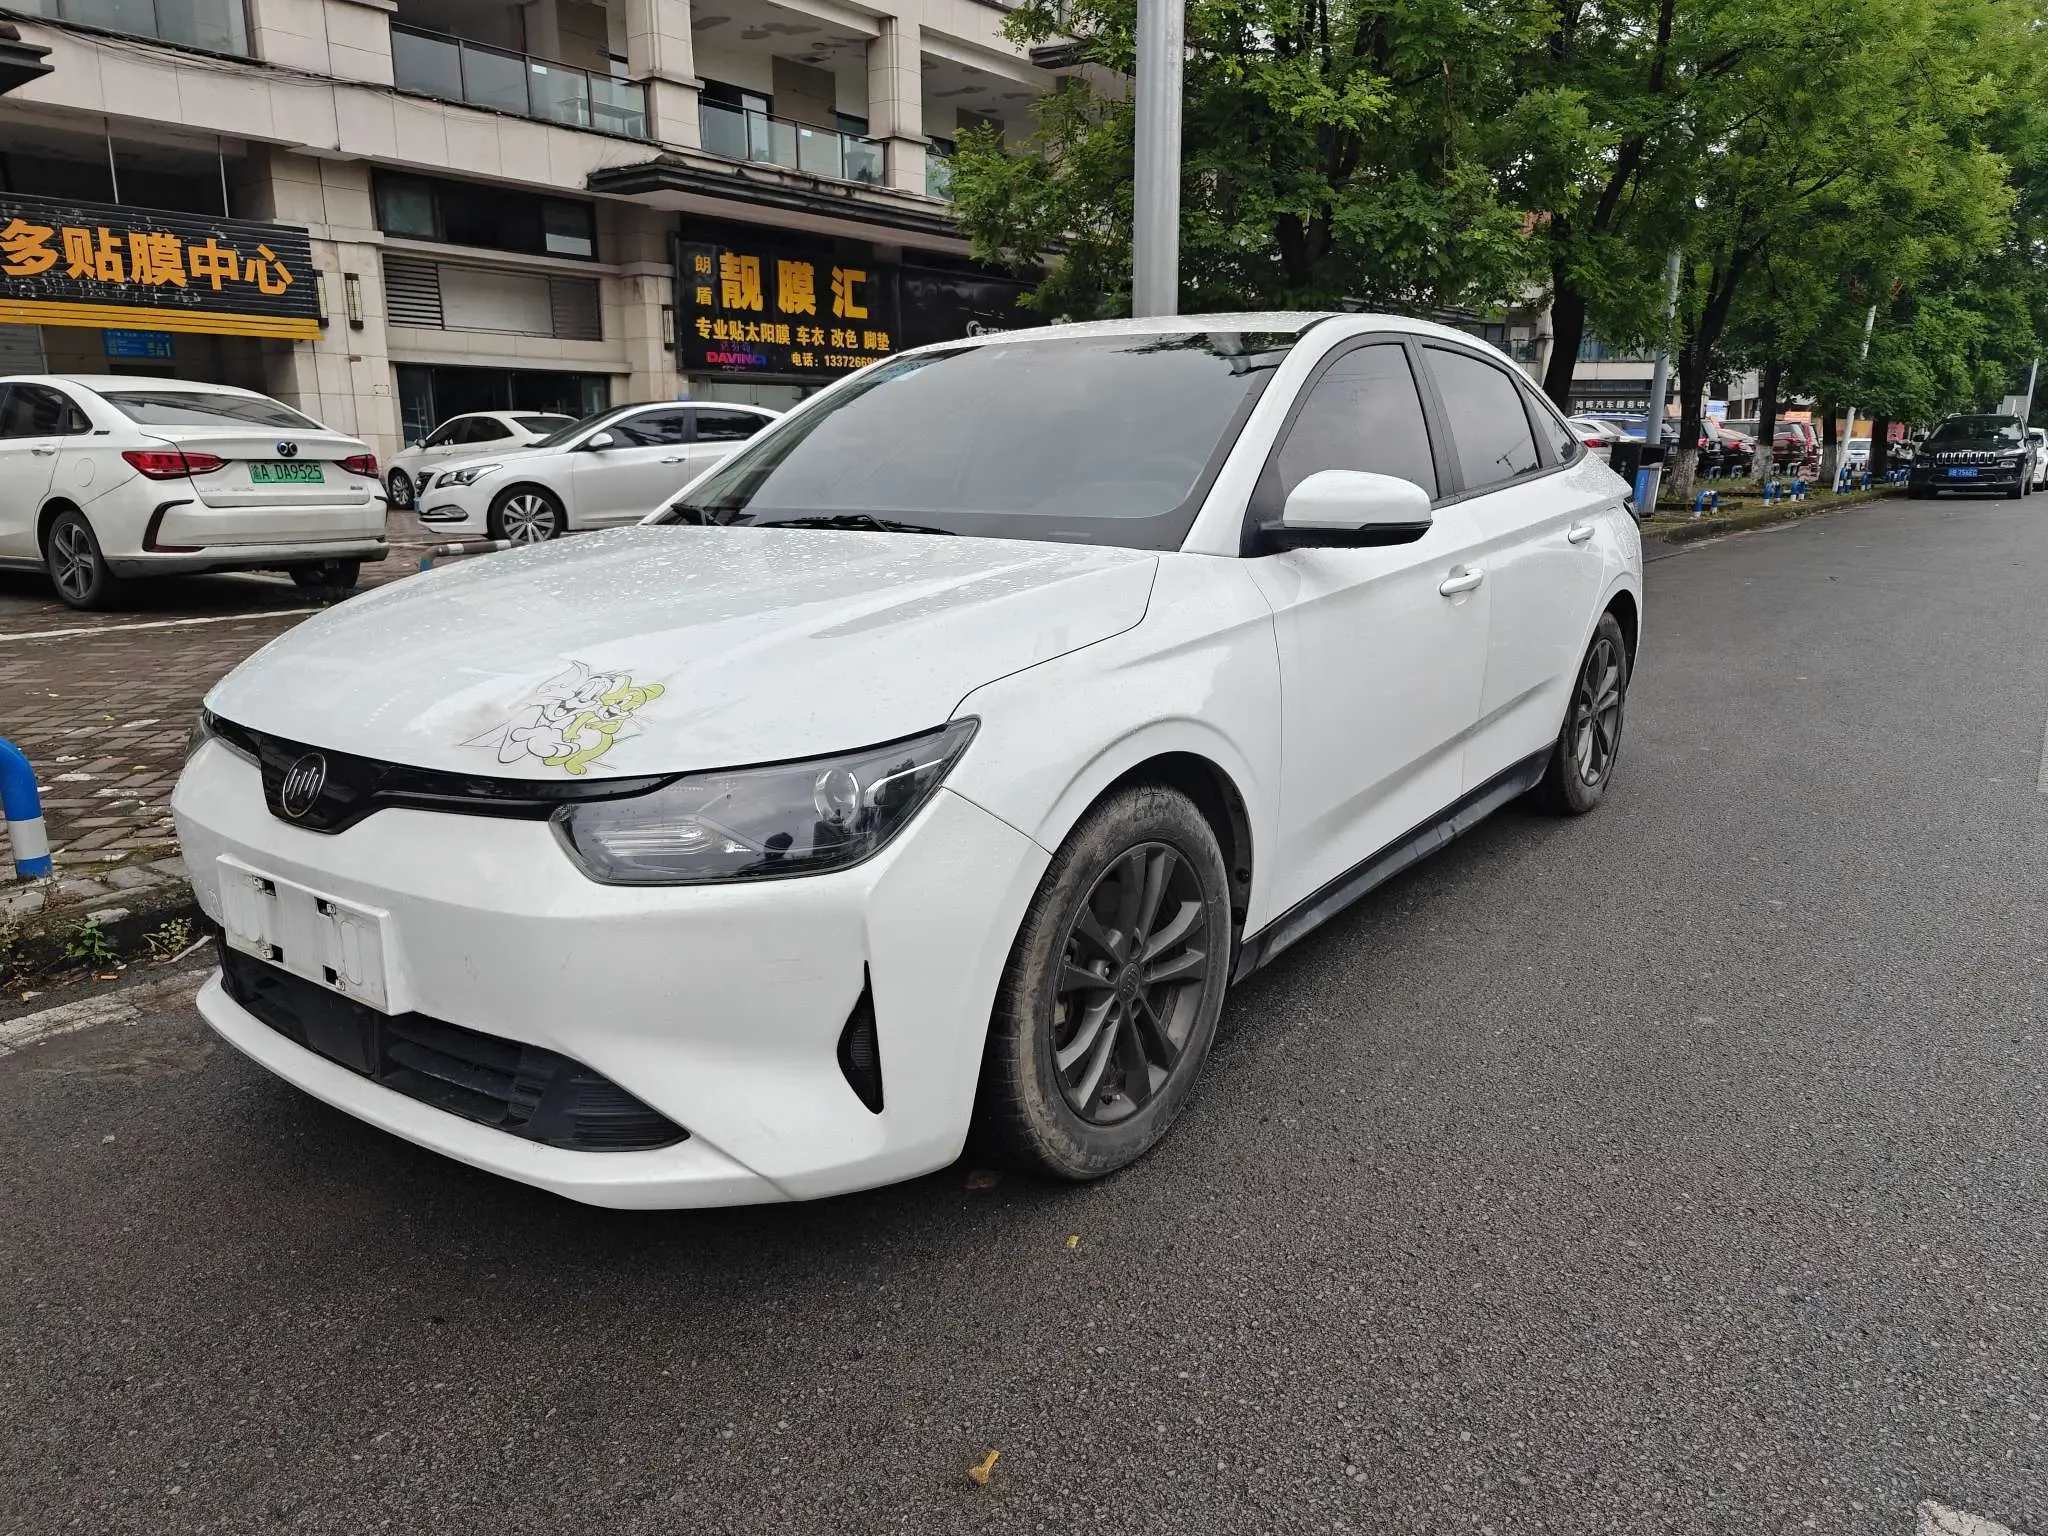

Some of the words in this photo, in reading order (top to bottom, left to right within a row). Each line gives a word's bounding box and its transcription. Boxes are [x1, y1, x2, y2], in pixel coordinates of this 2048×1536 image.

[1, 218, 293, 295] 多贴膜中心
[719, 252, 868, 319] 靓膜汇
[695, 316, 791, 345] 专业贴太阳膜
[796, 325, 825, 346] 车衣
[830, 328, 859, 349] 改色
[863, 331, 890, 351] 脚垫
